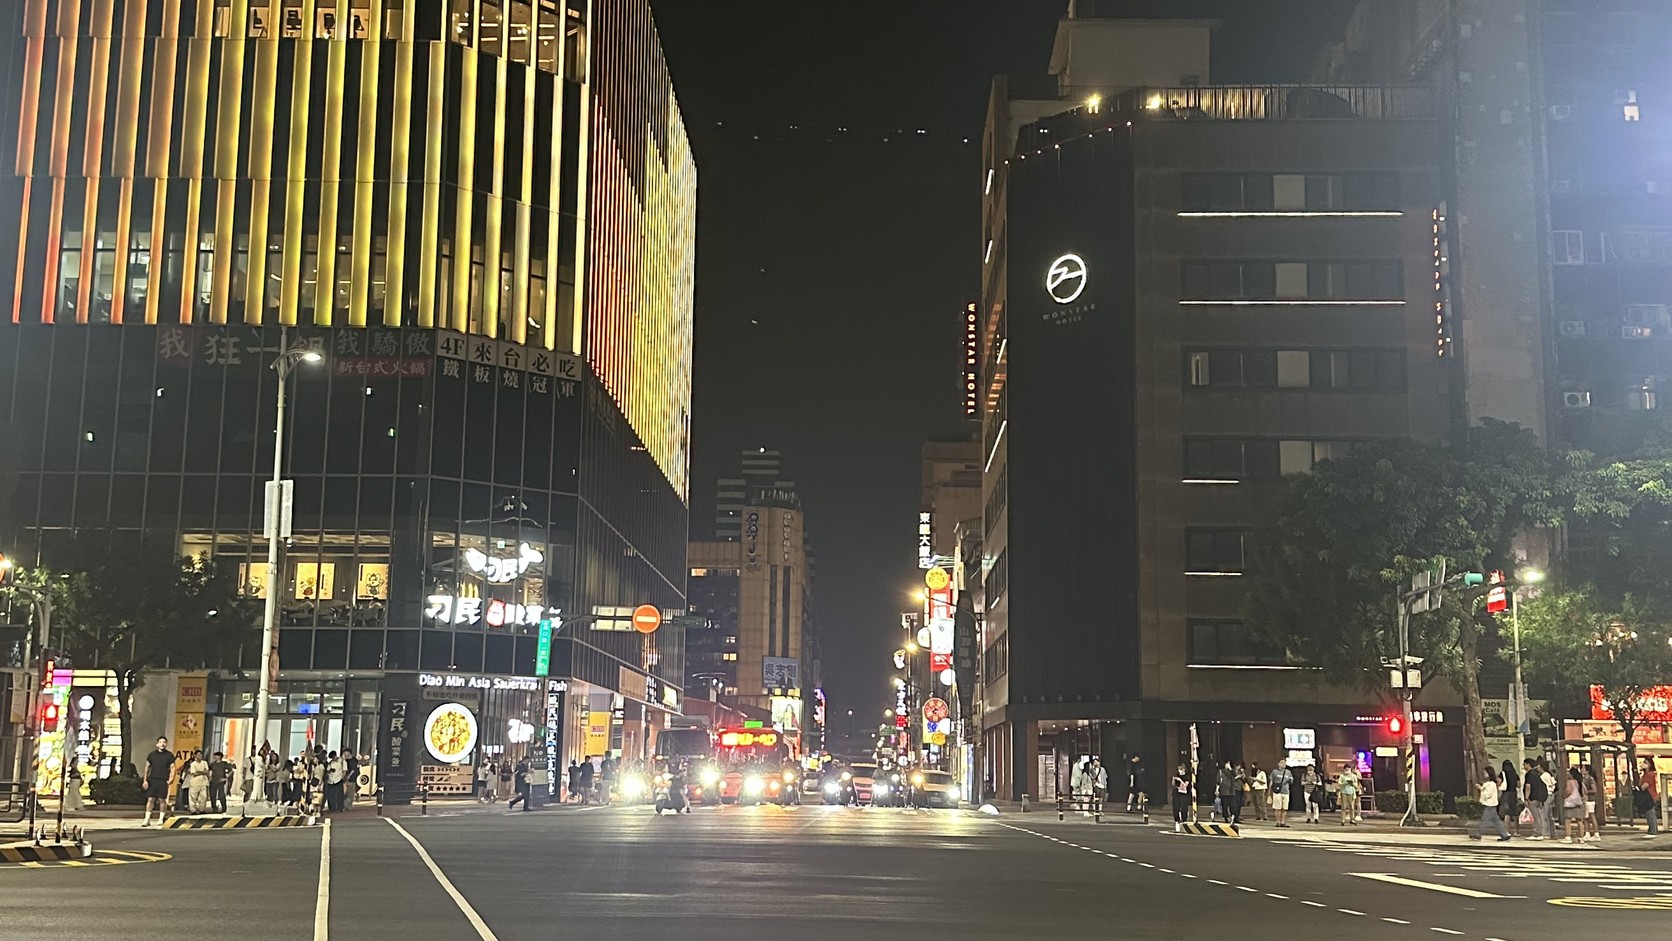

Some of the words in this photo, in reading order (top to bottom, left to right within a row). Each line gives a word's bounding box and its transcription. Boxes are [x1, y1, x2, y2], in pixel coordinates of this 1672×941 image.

[967, 303, 976, 365] WONSTAR
[338, 361, 426, 376] 新台式火鍋
[442, 358, 577, 398] 鐵板燒冠軍
[967, 373, 976, 414] HOTEL
[419, 674, 443, 686] Diao
[446, 675, 466, 687] Min
[467, 676, 491, 688] Asia
[548, 680, 567, 692] Fish
